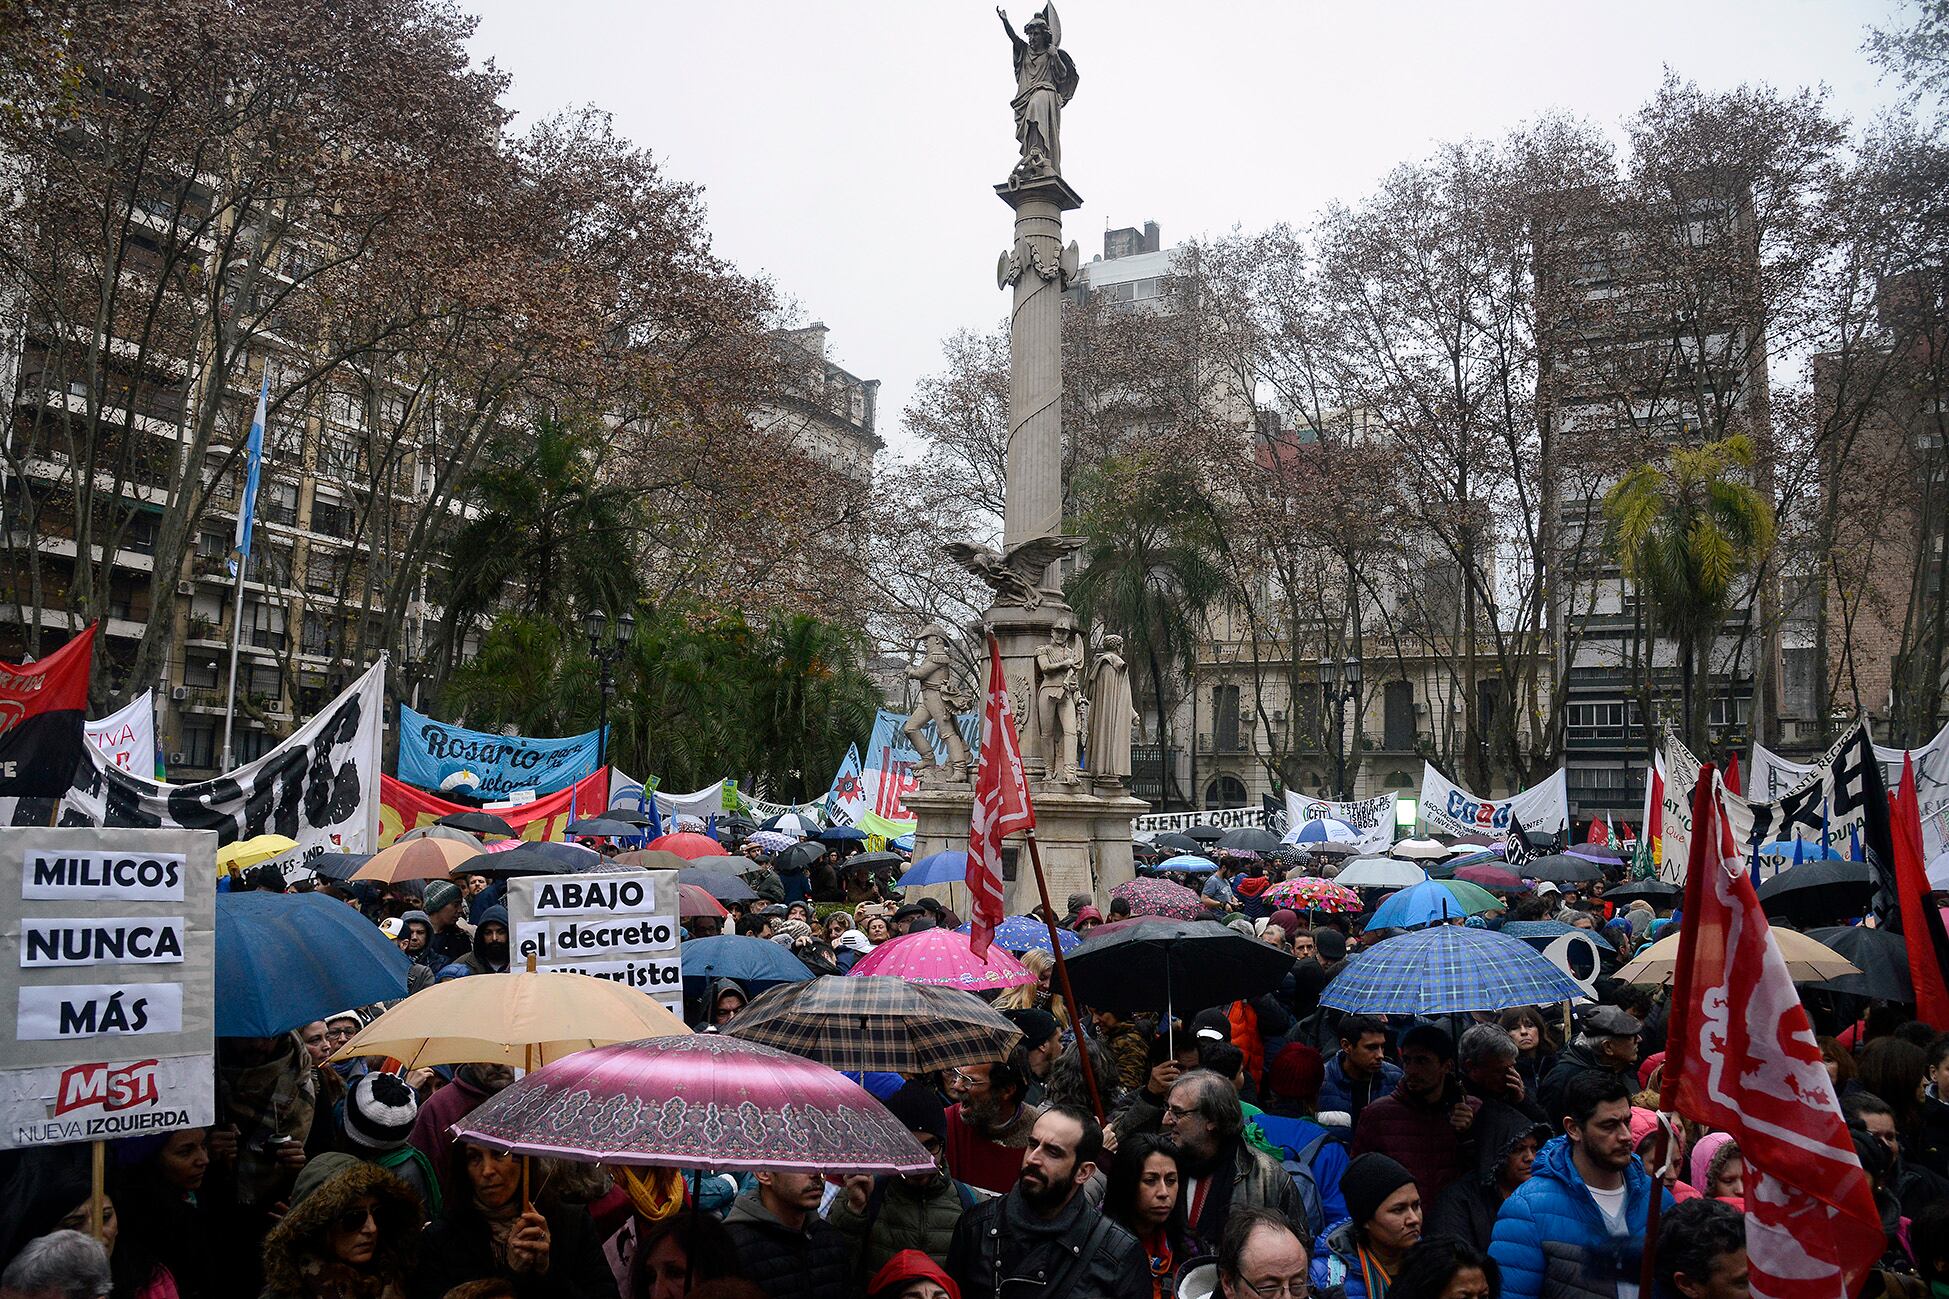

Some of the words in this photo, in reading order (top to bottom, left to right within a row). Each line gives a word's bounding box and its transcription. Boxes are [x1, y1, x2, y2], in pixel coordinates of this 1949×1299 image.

[421, 724, 543, 769] Rosario
[546, 744, 582, 765] para
[1135, 813, 1202, 831] FRENTE
[34, 857, 180, 888] MILICOS
[537, 881, 644, 911] ABAJO
[27, 926, 182, 961] NUNCA
[520, 932, 546, 958] el
[558, 922, 670, 950] decreto
[59, 991, 148, 1035] MÁS
[65, 1063, 158, 1107] MST
[19, 1121, 82, 1143] NUEVA
[86, 1110, 190, 1137] IZQUIERDA
